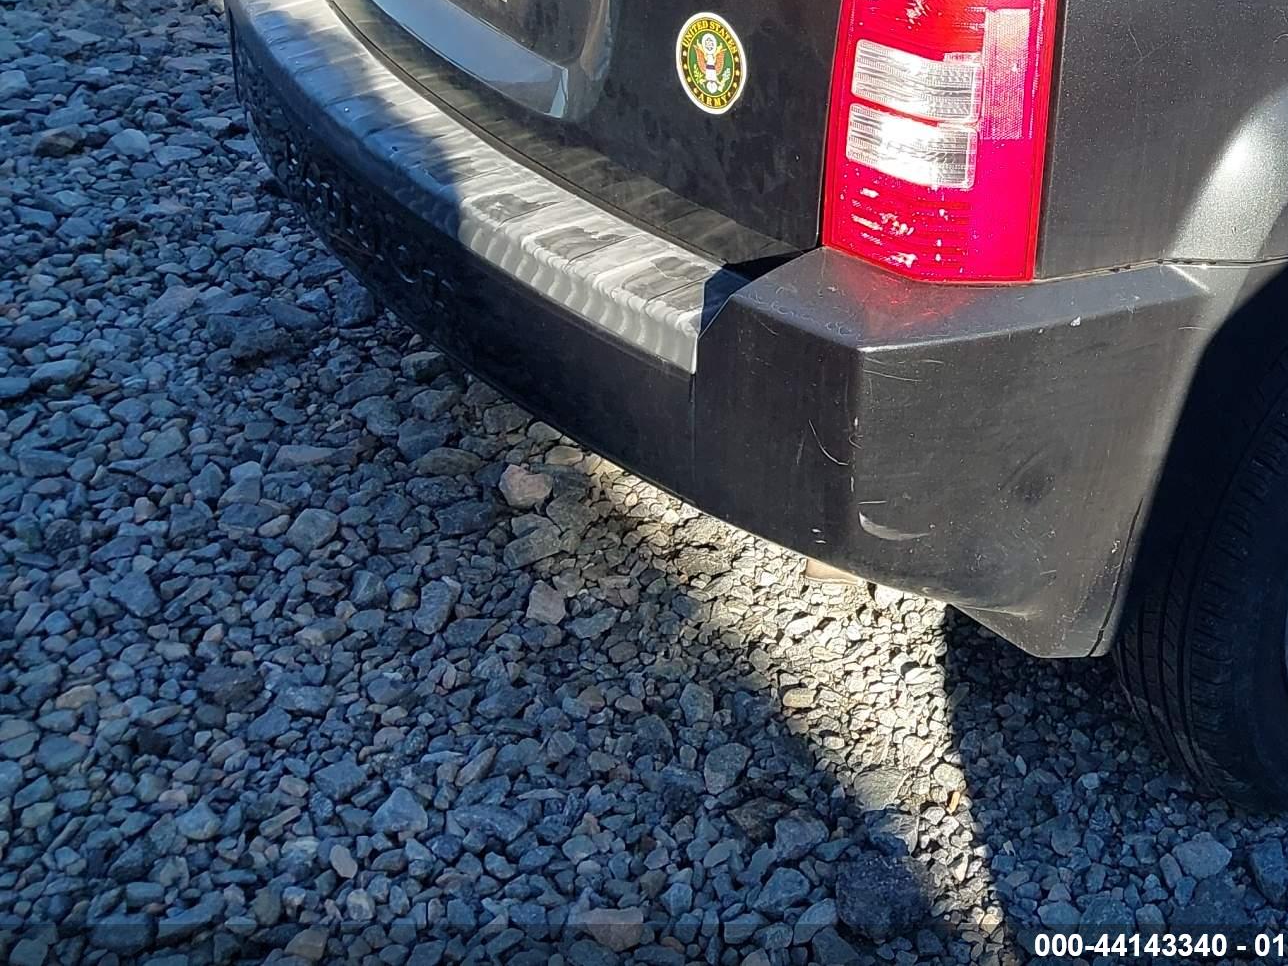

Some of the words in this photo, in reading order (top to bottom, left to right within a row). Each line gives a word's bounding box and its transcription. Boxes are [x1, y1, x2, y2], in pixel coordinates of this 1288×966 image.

[682, 20, 709, 47] UNITED
[709, 21, 738, 54] STATES
[698, 93, 728, 107] ARMY
